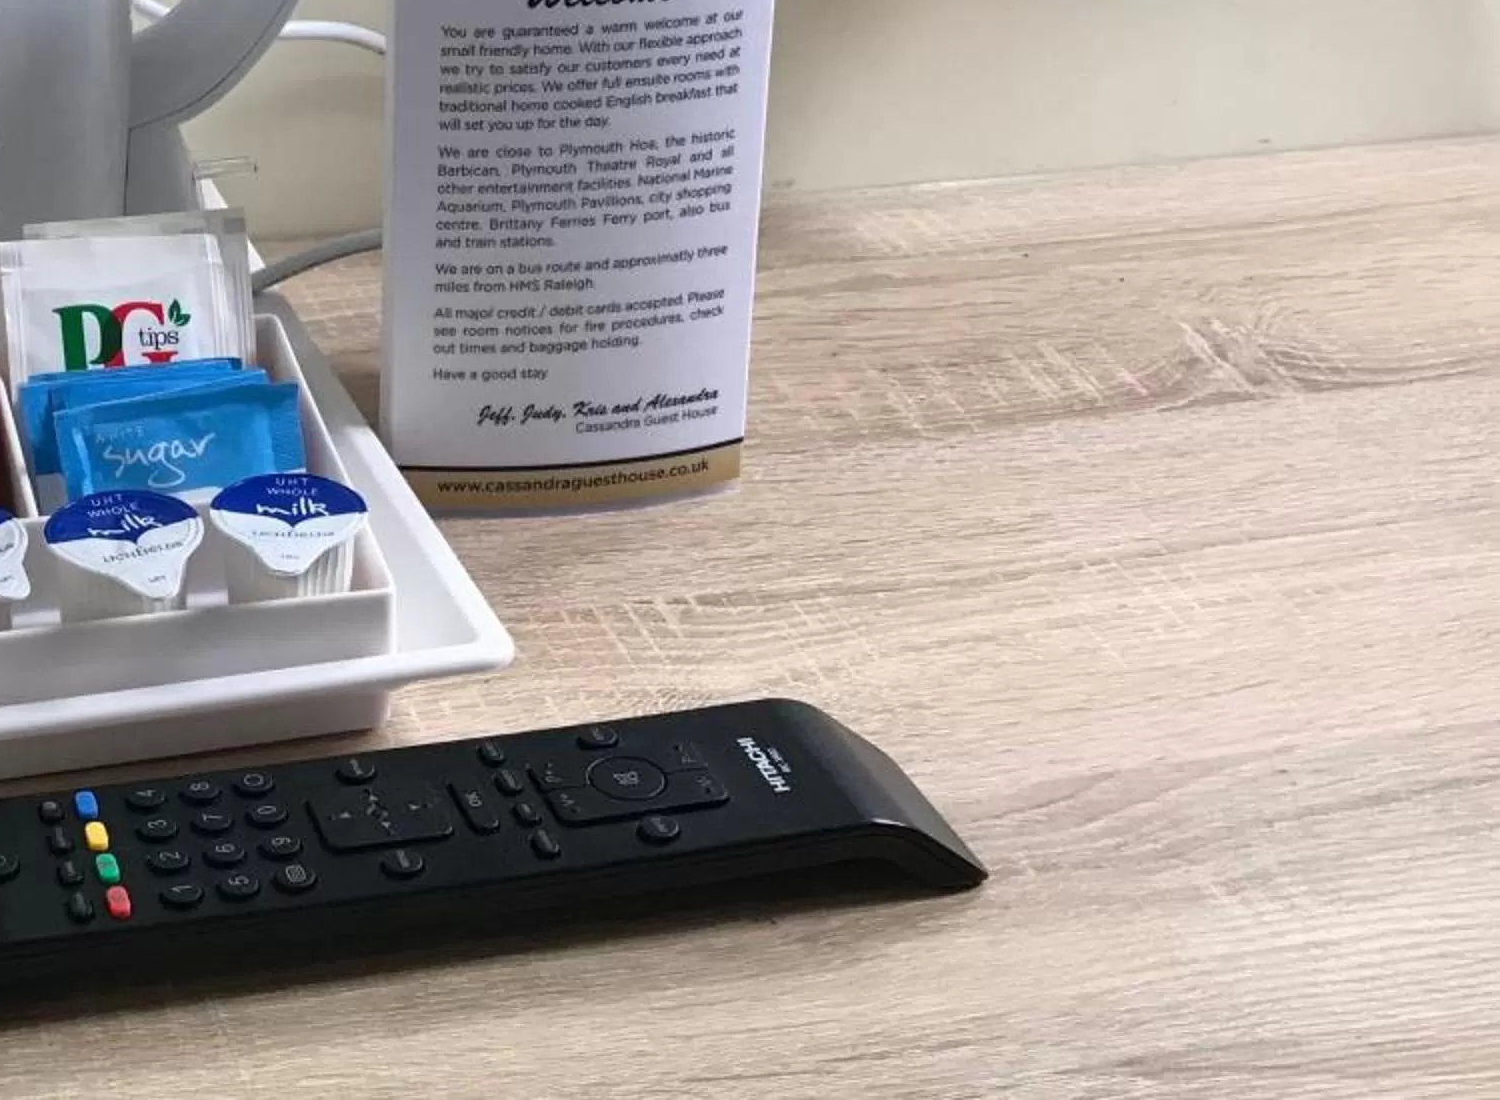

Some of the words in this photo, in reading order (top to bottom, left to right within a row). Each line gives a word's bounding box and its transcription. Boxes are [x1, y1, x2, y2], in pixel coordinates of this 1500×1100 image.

[441, 25, 467, 38] You
[474, 27, 496, 38] are
[502, 24, 578, 40] guaranteed
[602, 21, 637, 34] warm
[644, 16, 699, 31] welcome
[723, 10, 744, 22] our
[440, 44, 475, 56] small
[479, 44, 529, 58] friendly
[579, 40, 610, 53] With
[613, 41, 635, 52] our
[639, 36, 683, 49] flexible
[685, 28, 743, 47] approach
[440, 64, 460, 75] we
[465, 64, 484, 76] try
[489, 63, 504, 75] to
[508, 61, 552, 76] satisfy
[557, 63, 580, 73] our
[585, 57, 652, 73] customers
[657, 54, 690, 67] every
[696, 49, 724, 62] need
[439, 82, 490, 94] realistic
[541, 80, 563, 93] We
[567, 78, 598, 91] offer
[601, 76, 621, 89] full
[626, 73, 671, 88] ensuite
[673, 70, 711, 83] rooms
[715, 64, 740, 77] with
[439, 100, 507, 113] traditional
[511, 100, 549, 112] home
[553, 97, 602, 111] cooked
[606, 92, 652, 109] English
[656, 86, 712, 103] breakfast
[715, 83, 738, 97] that
[439, 118, 461, 131] will
[464, 119, 484, 130] set
[488, 119, 513, 132] you
[516, 119, 534, 131] up
[537, 117, 556, 129] for
[559, 116, 581, 129] the
[438, 145, 461, 159] We
[467, 147, 489, 159] are
[496, 146, 532, 158] close
[539, 145, 553, 157] to
[559, 141, 623, 159] Plymouth
[665, 135, 686, 148] the
[691, 128, 736, 144] historic
[511, 163, 577, 177] Plymouth
[588, 159, 637, 172] Theatre
[646, 153, 681, 168] Royal
[690, 149, 713, 163] and
[437, 182, 473, 195] other
[477, 181, 574, 195] entertainment
[638, 169, 691, 186] National
[693, 165, 733, 180] Marine
[511, 198, 577, 214] Plymouth
[649, 191, 673, 204] city
[676, 183, 732, 201] shopping
[489, 217, 544, 232] Brittany
[551, 215, 596, 228] Ferries
[603, 213, 637, 225] Ferry
[679, 204, 705, 218] also
[709, 201, 731, 213] bus
[436, 236, 461, 249] and
[465, 236, 496, 248] train
[435, 263, 457, 275] We
[461, 264, 482, 275] are
[486, 264, 503, 275] on
[519, 262, 543, 274] bus
[546, 261, 581, 273] route
[585, 258, 609, 271] and
[697, 245, 728, 258] three
[434, 281, 469, 293] miles
[473, 281, 505, 293] from
[509, 279, 540, 292] HMS
[434, 307, 453, 319] All
[455, 306, 494, 321] major
[497, 306, 537, 319] credit
[549, 304, 584, 317] debit
[587, 301, 621, 315] cards
[688, 289, 725, 304] Please
[433, 326, 457, 337] see
[463, 326, 499, 337] room
[505, 324, 553, 336] notices
[560, 320, 579, 334] for
[585, 320, 606, 332] fire
[689, 305, 724, 321] check
[53, 301, 179, 373] PG
[139, 327, 180, 351] tips
[433, 343, 456, 354] out
[460, 342, 497, 354] times
[501, 341, 526, 354] and
[529, 340, 587, 355] baggage
[432, 368, 466, 381] Have
[482, 367, 517, 383] good
[572, 400, 608, 418] Kris
[611, 397, 642, 415] and
[642, 387, 719, 413] Alexandra
[575, 415, 641, 434] Cassandra
[644, 410, 680, 428] Guest
[682, 405, 718, 421] House
[102, 432, 217, 488] sugar
[438, 457, 709, 493] www.cassandraguesthouse.co.uk
[265, 487, 318, 497] WHOLE
[275, 477, 309, 486] UHT
[87, 501, 140, 518] WHOLE
[91, 493, 123, 507] UHT
[256, 496, 330, 517] milk
[87, 513, 164, 536] milk
[736, 736, 791, 795] HITACHI
